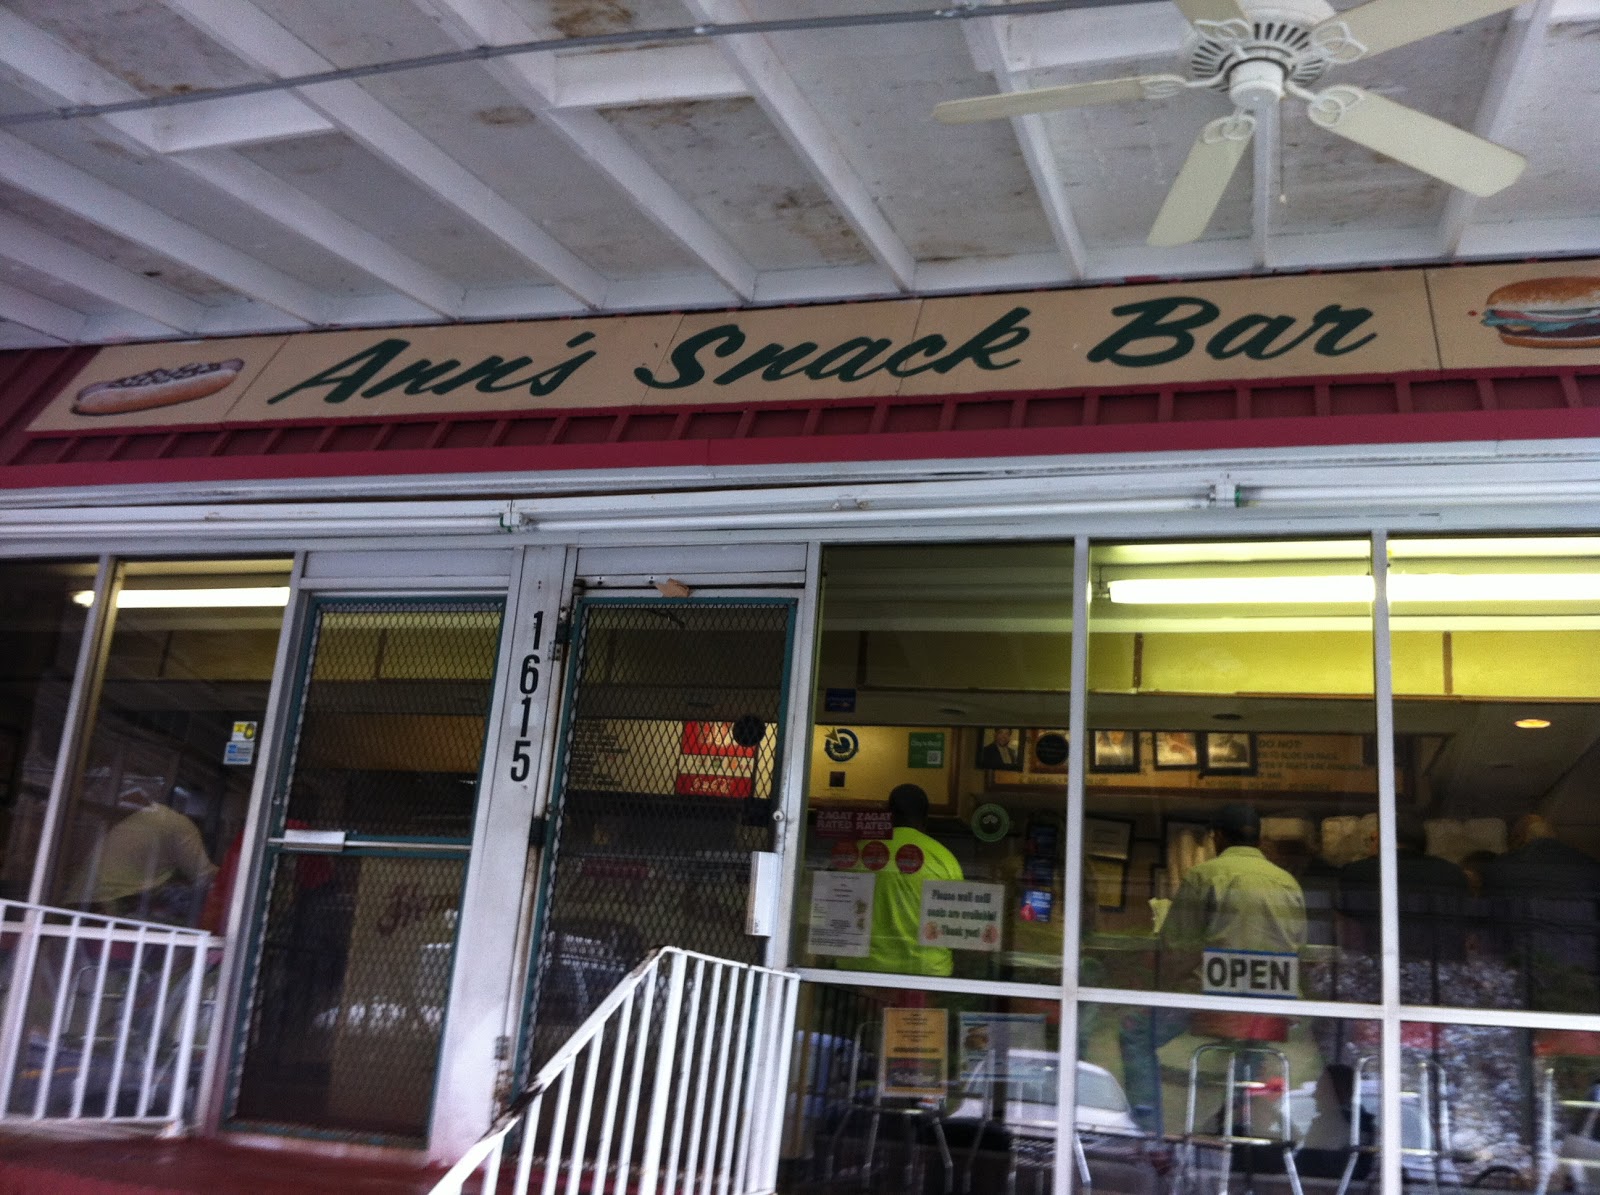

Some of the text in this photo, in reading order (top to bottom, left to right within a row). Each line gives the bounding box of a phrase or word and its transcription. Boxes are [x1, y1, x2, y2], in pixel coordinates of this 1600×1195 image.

[268, 296, 1376, 403] Ann's Snack Bar
[510, 611, 544, 782] 1615
[816, 810, 853, 820] ZAGAT
[856, 812, 893, 821] ZAGAT
[816, 820, 853, 829] RATED
[855, 821, 893, 830] RATED
[1207, 957, 1290, 990] OPEN
